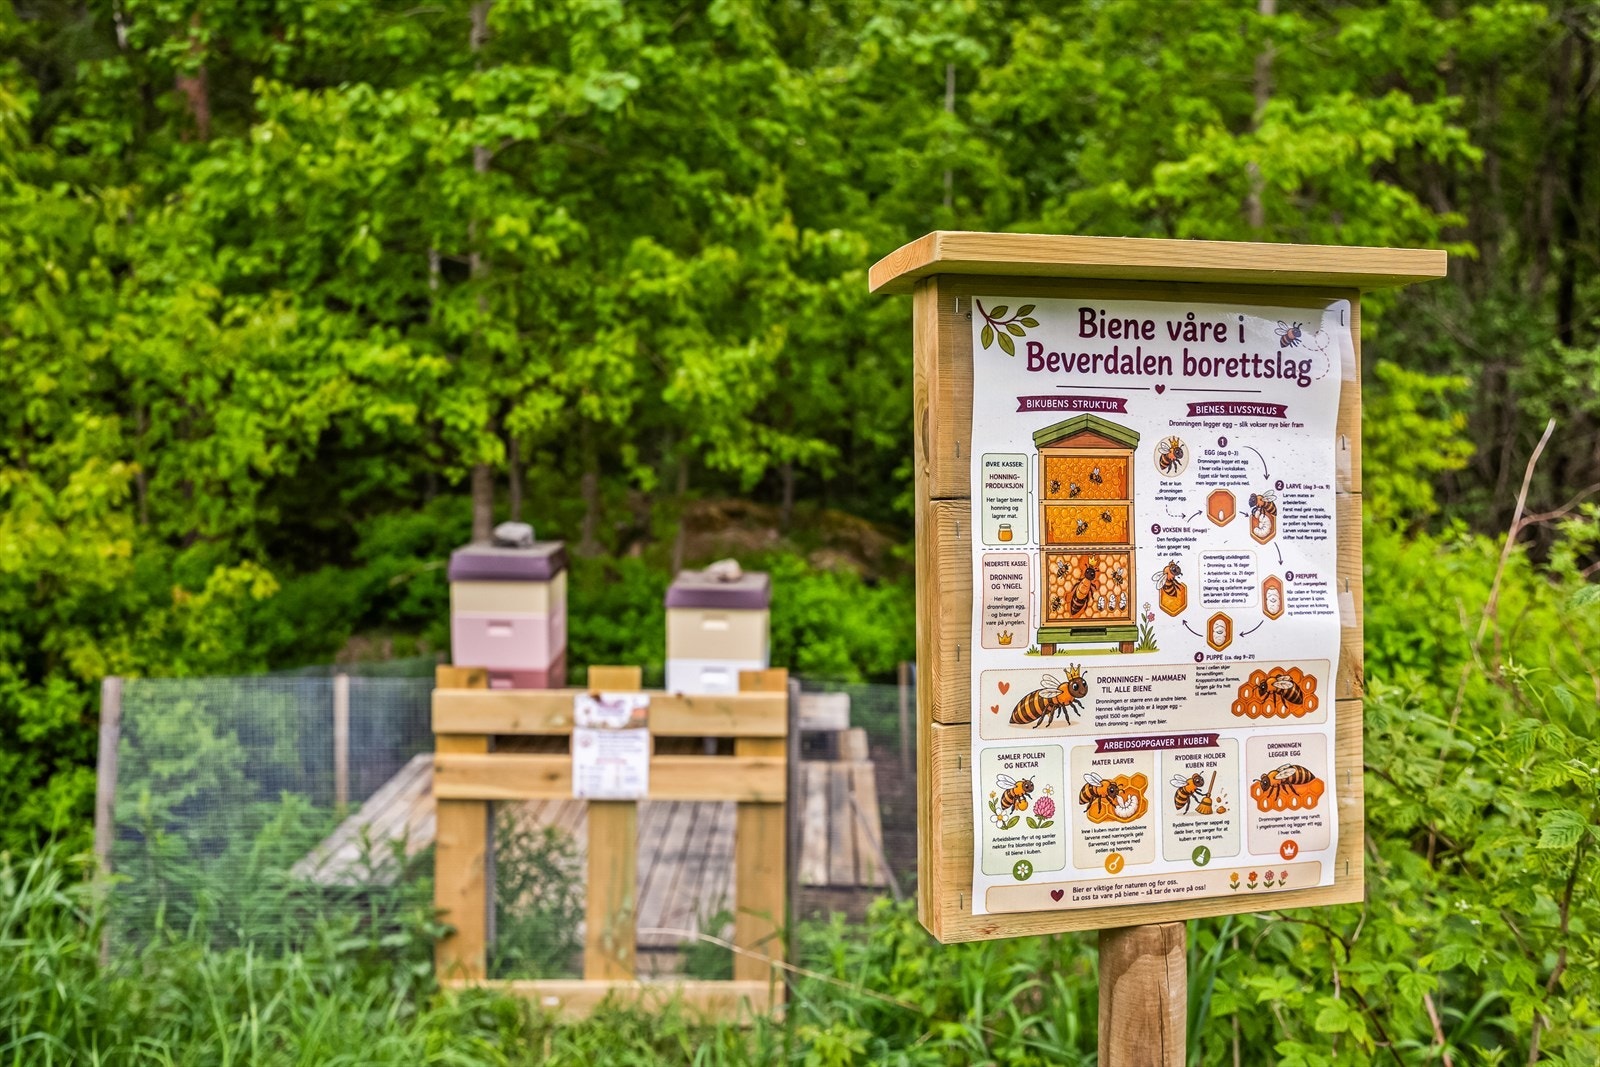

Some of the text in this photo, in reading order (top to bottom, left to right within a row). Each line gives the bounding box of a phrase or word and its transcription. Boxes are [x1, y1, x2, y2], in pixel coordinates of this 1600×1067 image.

[1077, 307, 1245, 343] Biene våre i
[1026, 342, 1312, 387] Beverdalen borettslag
[1026, 399, 1118, 409] BIKUBENS STRUKTUR
[1196, 405, 1277, 414] BIENES LIVSSYKLUS
[1169, 420, 1202, 428] Dronningen
[1097, 676, 1144, 684] DRONNINGEN
[1104, 739, 1175, 749] ARBEIDSOPPGAVER
[1183, 737, 1209, 745] KUBEN
[1186, 885, 1194, 893] på
